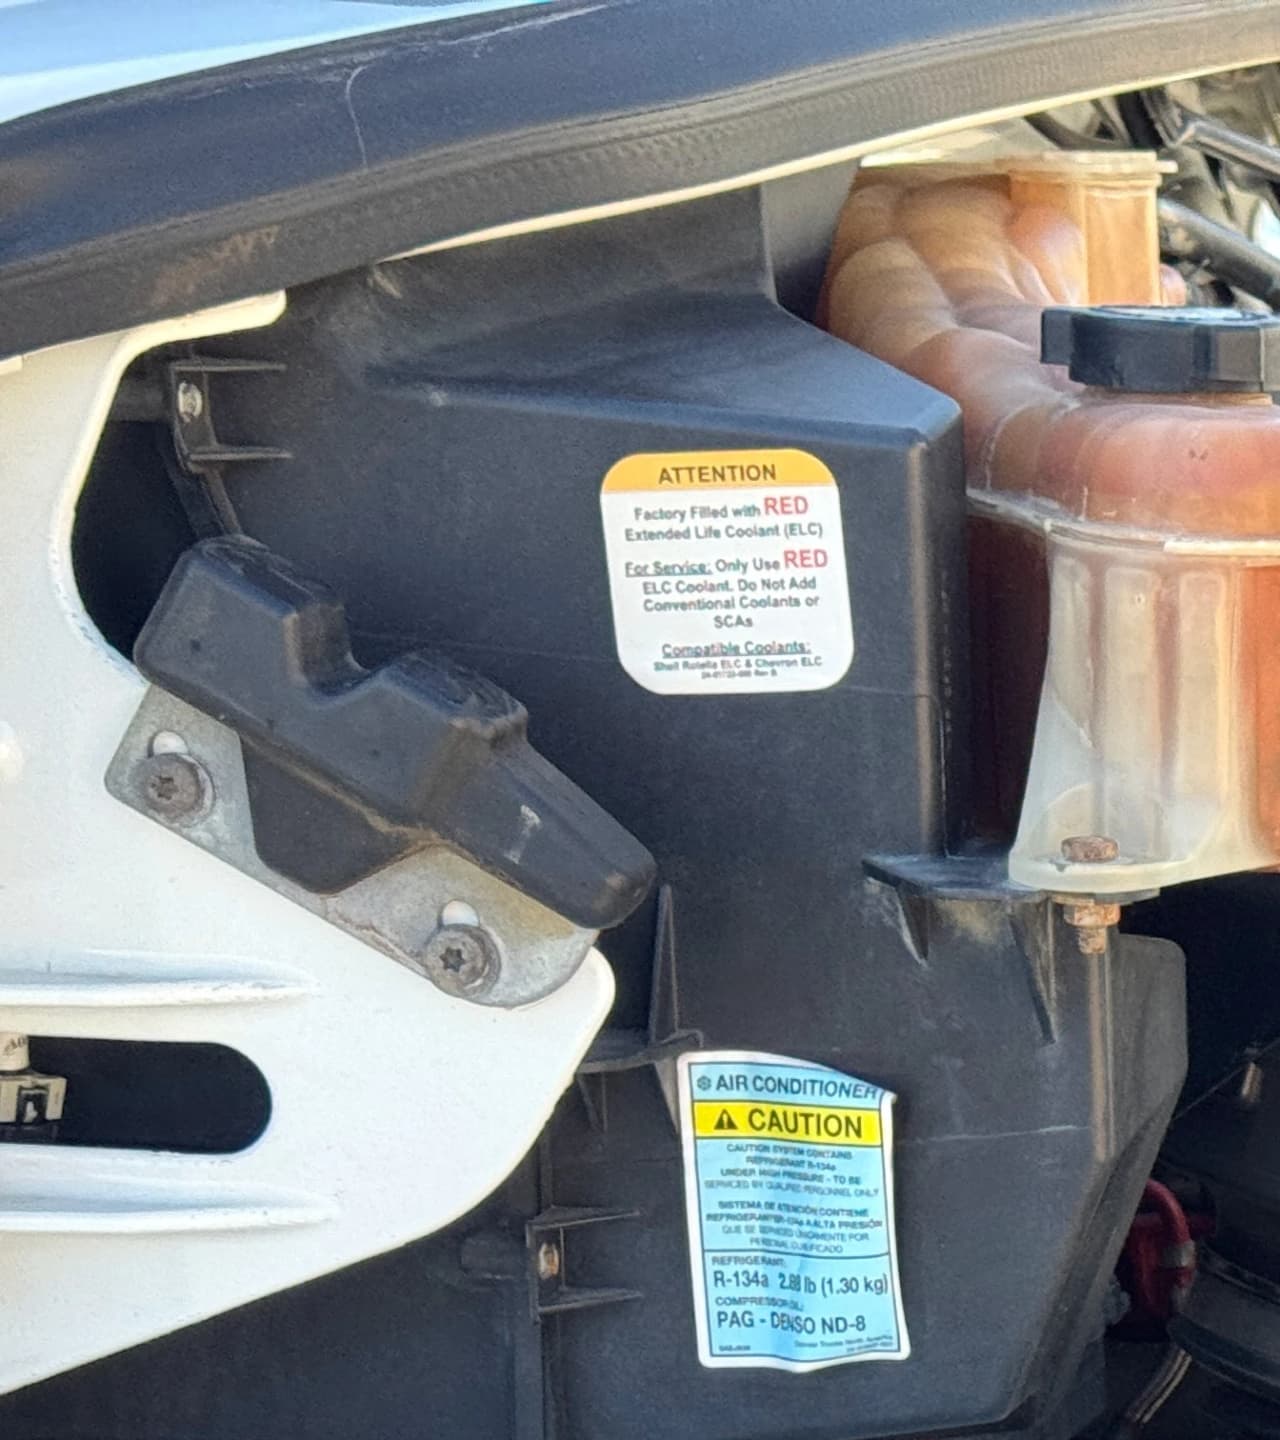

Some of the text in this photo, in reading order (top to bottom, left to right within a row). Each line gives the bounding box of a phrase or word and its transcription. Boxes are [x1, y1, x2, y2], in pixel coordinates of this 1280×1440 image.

[658, 464, 776, 484] ATTENTION
[634, 496, 808, 523] Factory Filled with RED
[625, 522, 823, 541] Extended Life Coolant (ELC)
[625, 550, 828, 577] For Service: Only Use RED
[643, 581, 671, 595] ELC
[738, 580, 757, 592] Do
[762, 578, 785, 590] Not
[789, 577, 816, 589] Add
[644, 597, 819, 612] Conventional Coolants or
[714, 616, 753, 628] SCAs
[662, 641, 811, 658] Compatible Coolants:
[801, 656, 822, 666] ELC
[716, 1074, 876, 1100] AIR CONDITIONER
[749, 1108, 862, 1138] CAUTION
[720, 1169, 756, 1177] UNDER
[833, 1176, 846, 1184] TO
[714, 1270, 769, 1288] R-134a
[804, 1275, 816, 1293] lb
[822, 1277, 859, 1298] (1.30
[864, 1273, 888, 1296] kg)
[717, 1310, 754, 1328] PAG
[822, 1315, 866, 1334] ND-8
